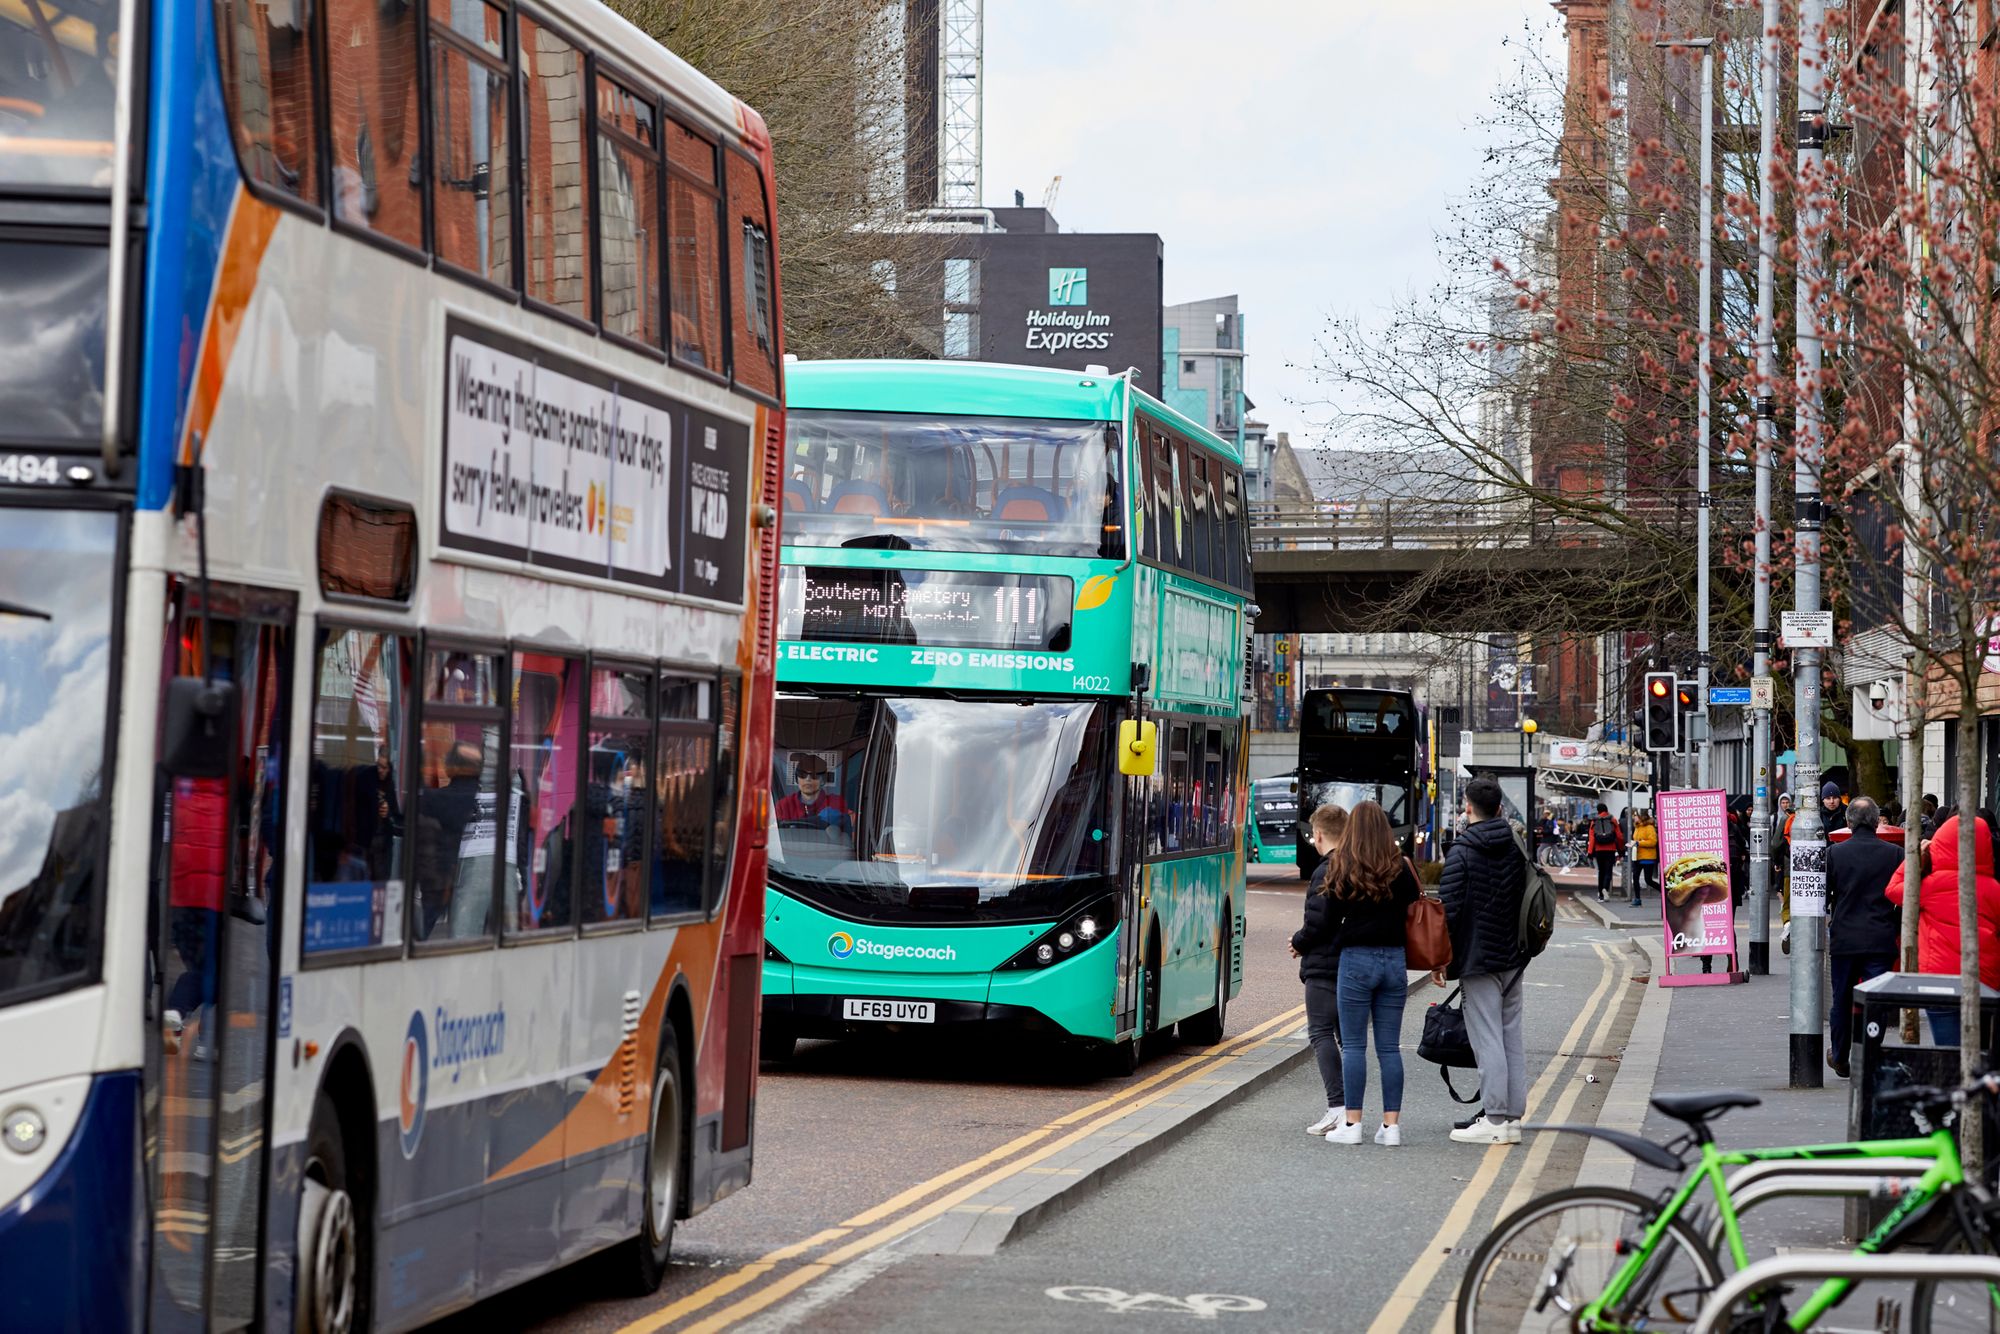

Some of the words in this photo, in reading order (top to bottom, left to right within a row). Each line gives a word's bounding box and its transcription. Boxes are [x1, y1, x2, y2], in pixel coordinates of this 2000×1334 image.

[1026, 310, 1084, 329] Holiday
[1086, 310, 1110, 326] Inn
[1025, 328, 1109, 354] Express
[455, 352, 511, 446] Wearing
[533, 400, 566, 445] same
[568, 406, 599, 466] pants
[0, 454, 61, 485] 494
[452, 461, 488, 527] sorry
[489, 447, 530, 518] fellow
[531, 469, 582, 532] travellers
[804, 579, 880, 601] Southern
[890, 582, 970, 607] Cemetery
[993, 586, 1037, 624] 111
[788, 645, 879, 663] ELECTRIC
[911, 651, 963, 666] ZERO
[968, 653, 1075, 672] EMISSIONS
[1073, 675, 1111, 692] 14022
[1662, 797, 1677, 807] THE
[1678, 795, 1721, 807] SUPERSTAR
[1663, 808, 1678, 819] THE
[1679, 806, 1721, 818] SUPERSTAR
[1664, 820, 1679, 830] THE
[1680, 817, 1722, 829] SUPERSTAR
[1664, 831, 1679, 841] THE
[1680, 828, 1723, 840] SUPERSTAR
[1665, 841, 1680, 852] THE
[1681, 839, 1723, 851] SUPERSTAR
[1702, 904, 1727, 915] RSTAR
[855, 938, 956, 961] Stagecoach
[1671, 930, 1728, 950] Archie's
[850, 1001, 892, 1018] LF69
[896, 1003, 928, 1020] UYO
[433, 1001, 506, 1084] Stagecoach
